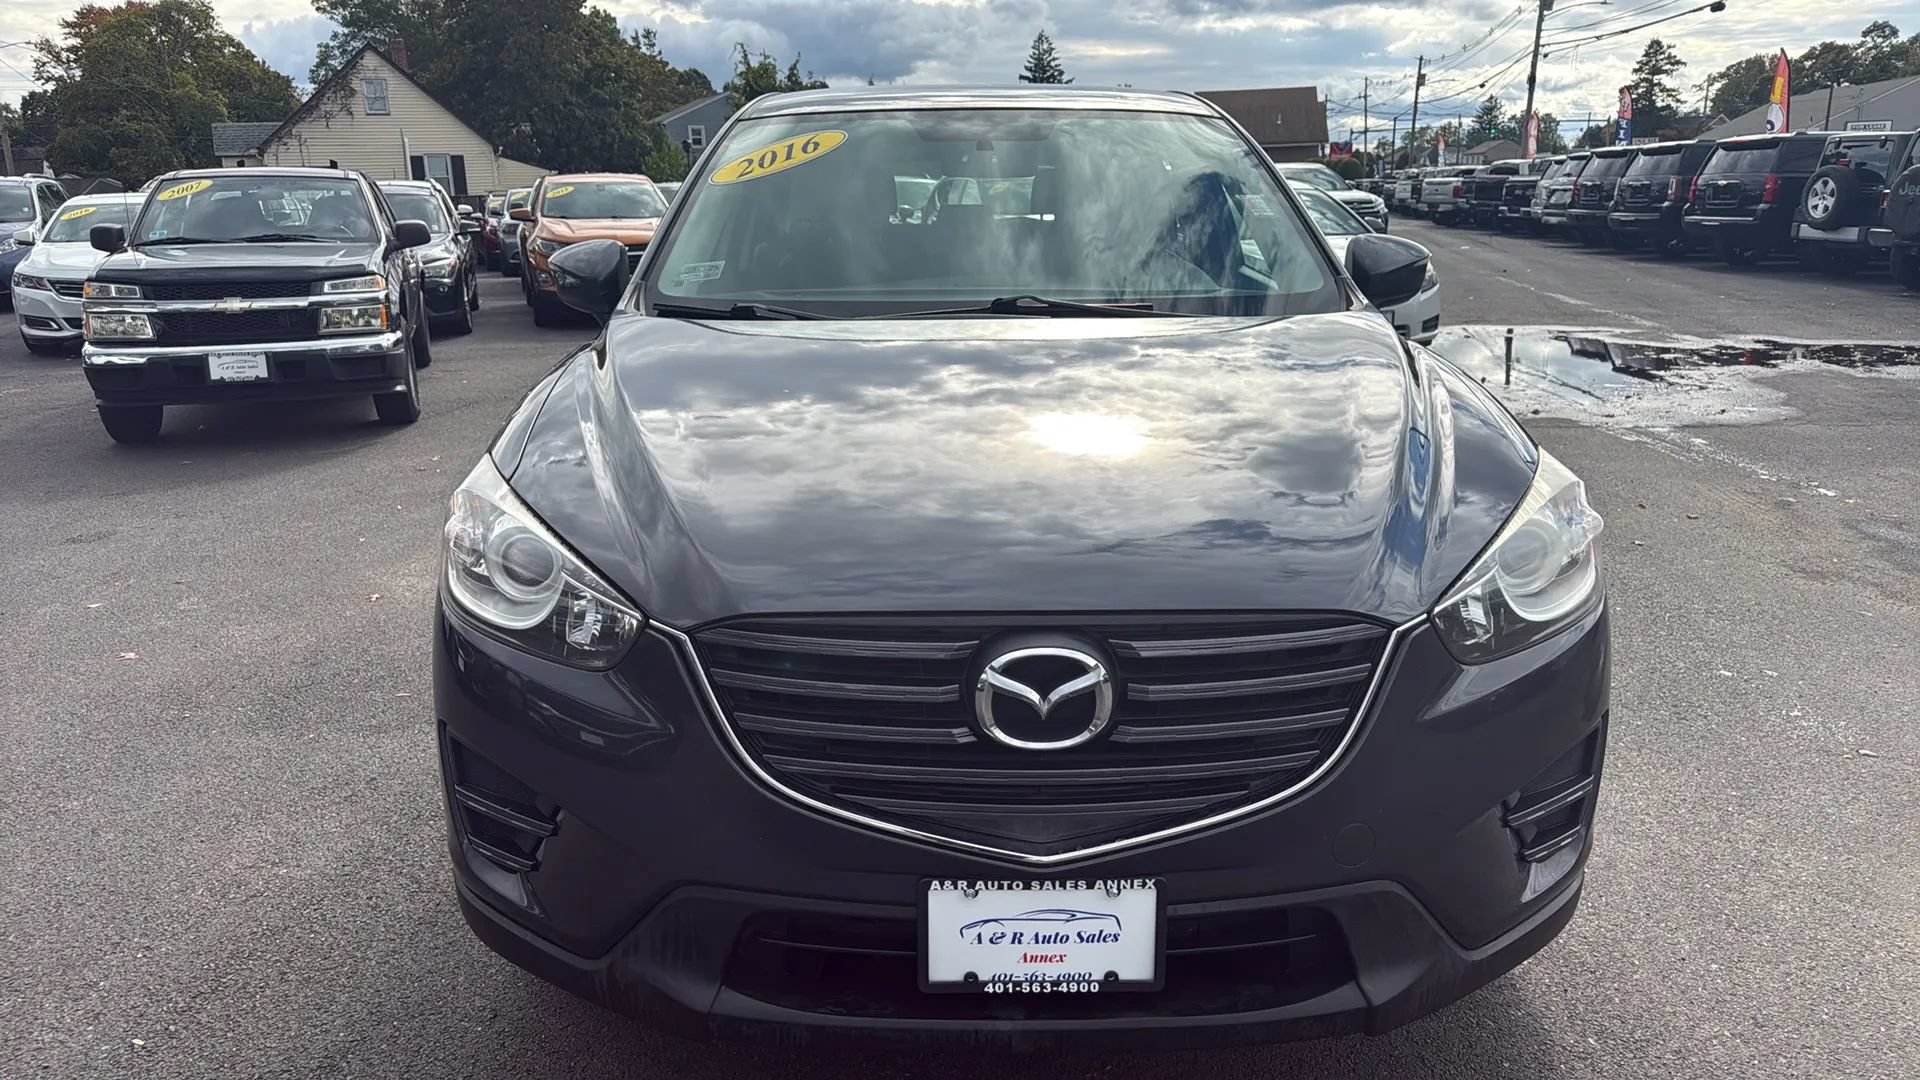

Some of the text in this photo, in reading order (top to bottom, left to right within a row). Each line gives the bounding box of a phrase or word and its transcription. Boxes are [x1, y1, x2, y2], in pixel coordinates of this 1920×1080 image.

[736, 134, 820, 179] 2016
[168, 181, 202, 198] 2007
[929, 879, 1157, 890] A&R AUTO SALES ANNEX
[970, 929, 1121, 945] A & R Auto Sales
[1017, 952, 1067, 963] Annex
[984, 982, 1100, 993] 401-563-4900
